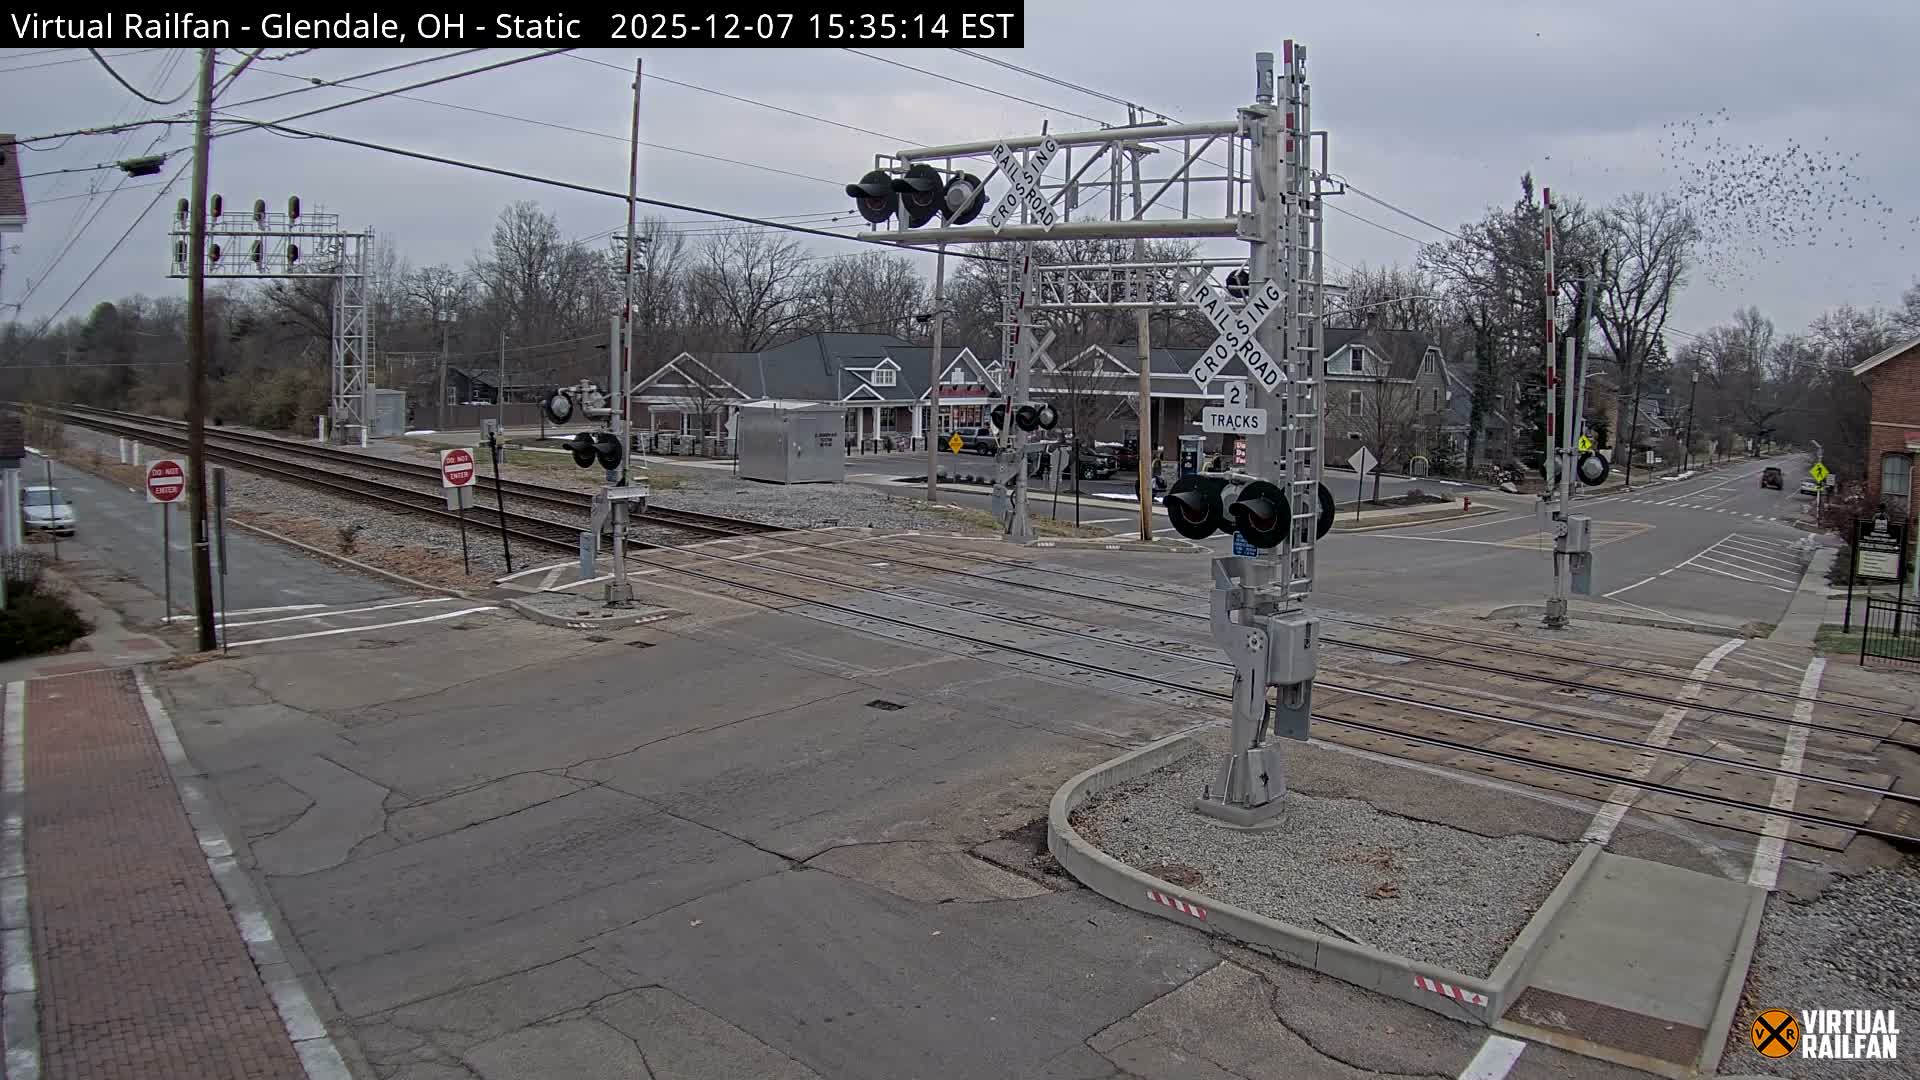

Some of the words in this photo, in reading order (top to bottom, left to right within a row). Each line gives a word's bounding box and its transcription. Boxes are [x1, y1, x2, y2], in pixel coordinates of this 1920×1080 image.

[990, 139, 1056, 228] CROSSING
[1194, 285, 1280, 384] CROSSING
[1210, 413, 1259, 430] TRACKS
[1229, 387, 1240, 405] 2
